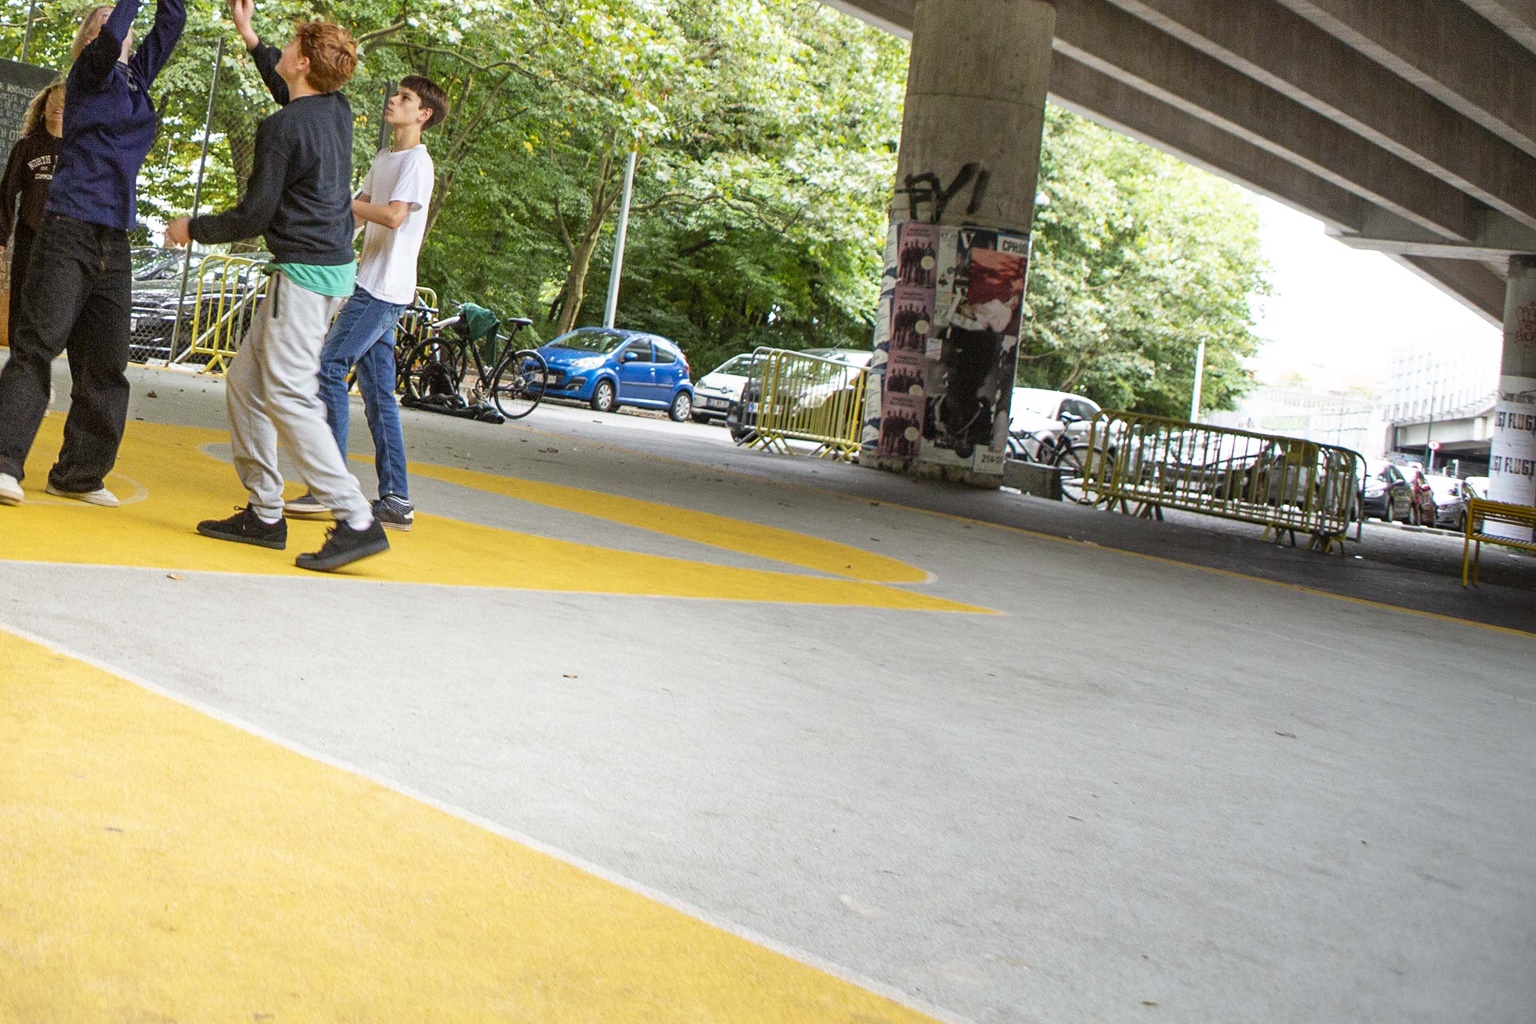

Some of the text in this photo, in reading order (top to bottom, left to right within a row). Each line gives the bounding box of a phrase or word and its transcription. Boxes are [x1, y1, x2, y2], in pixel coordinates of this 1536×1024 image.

[7, 83, 38, 98] KNOWLED
[27, 155, 51, 170] NORTH
[1508, 412, 1536, 433] FLUG
